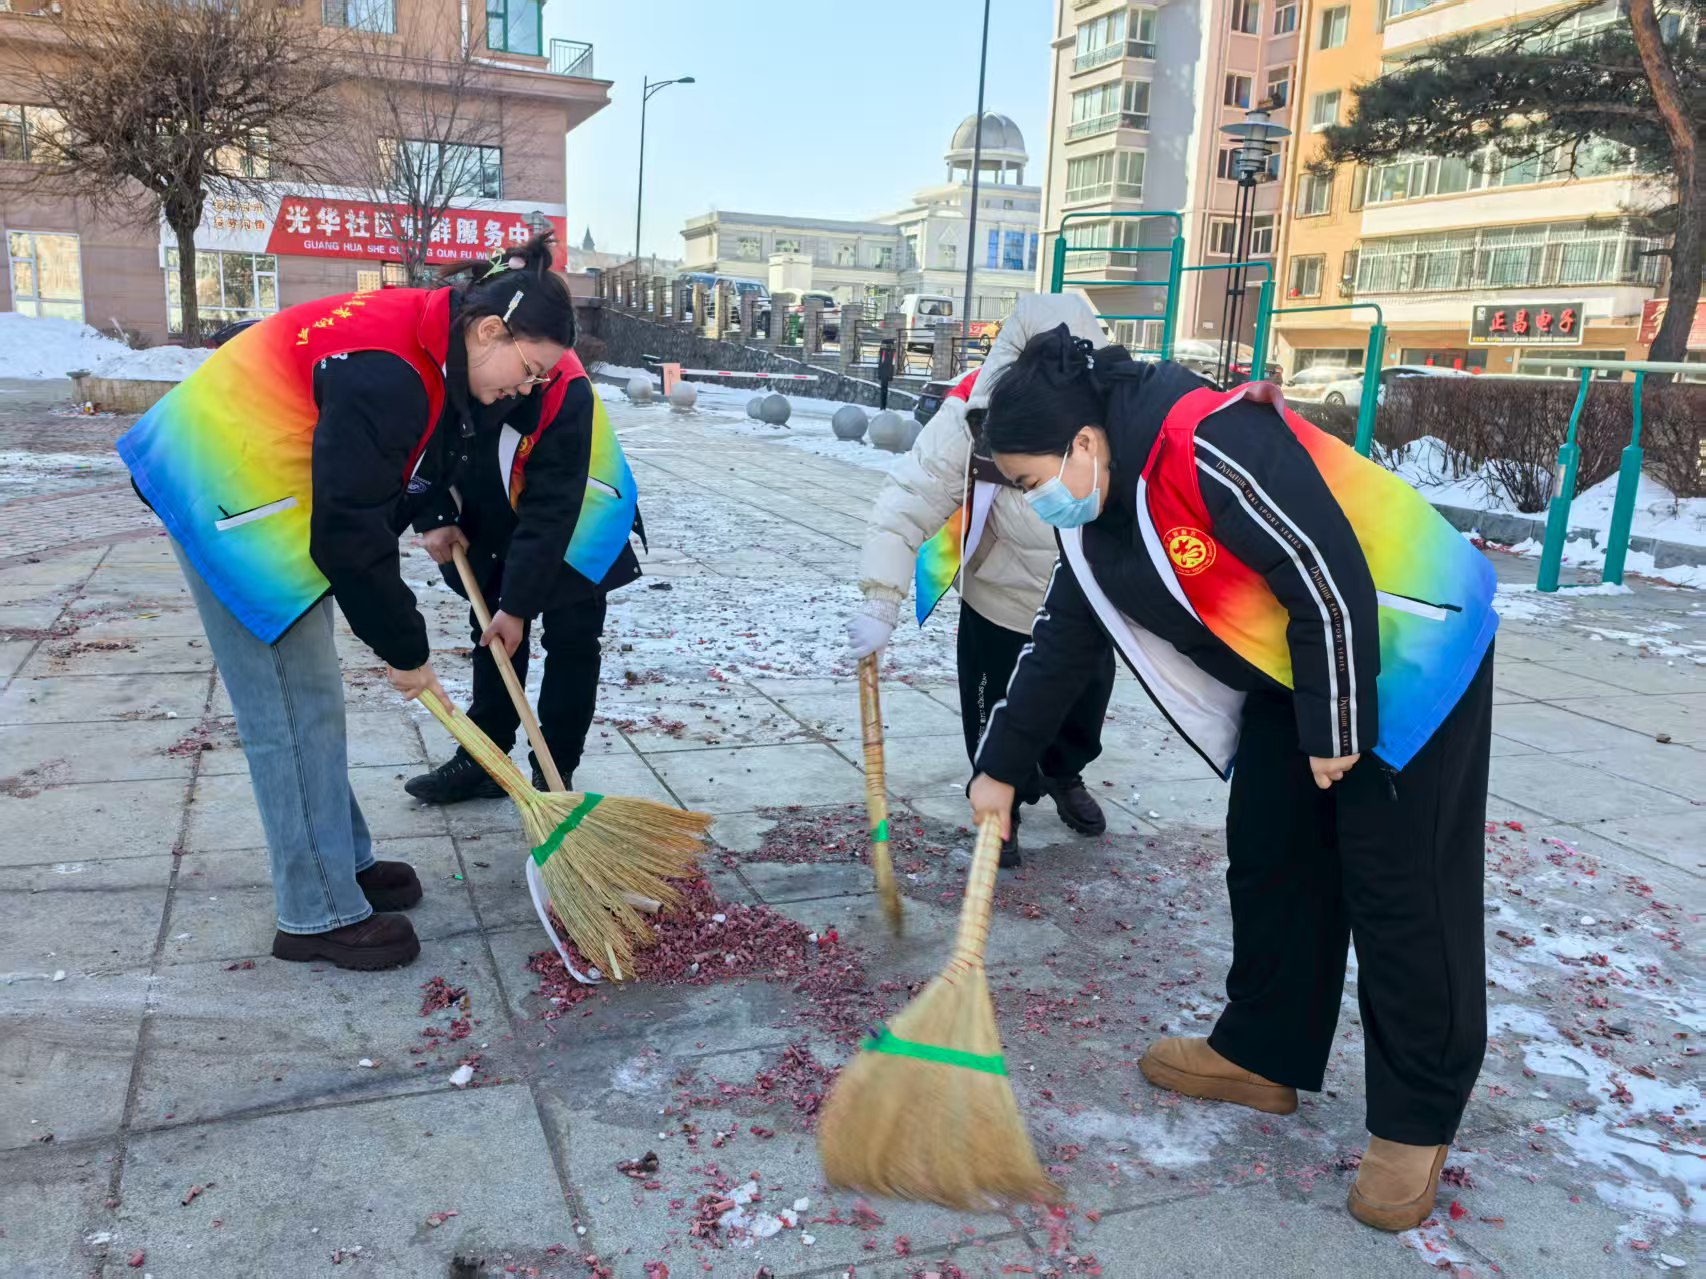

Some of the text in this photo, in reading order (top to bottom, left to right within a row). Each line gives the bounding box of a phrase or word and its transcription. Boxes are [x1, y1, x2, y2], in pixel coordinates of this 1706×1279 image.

[285, 205, 556, 247] 光华社区党群服务中
[303, 239, 340, 251] GUANG
[343, 242, 363, 252] HUA
[367, 244, 385, 254] SHE
[460, 249, 472, 260] FU
[1489, 308, 1575, 334] 正昌电子
[1258, 505, 1280, 526] SPORT
[1279, 526, 1304, 550] SERIES
